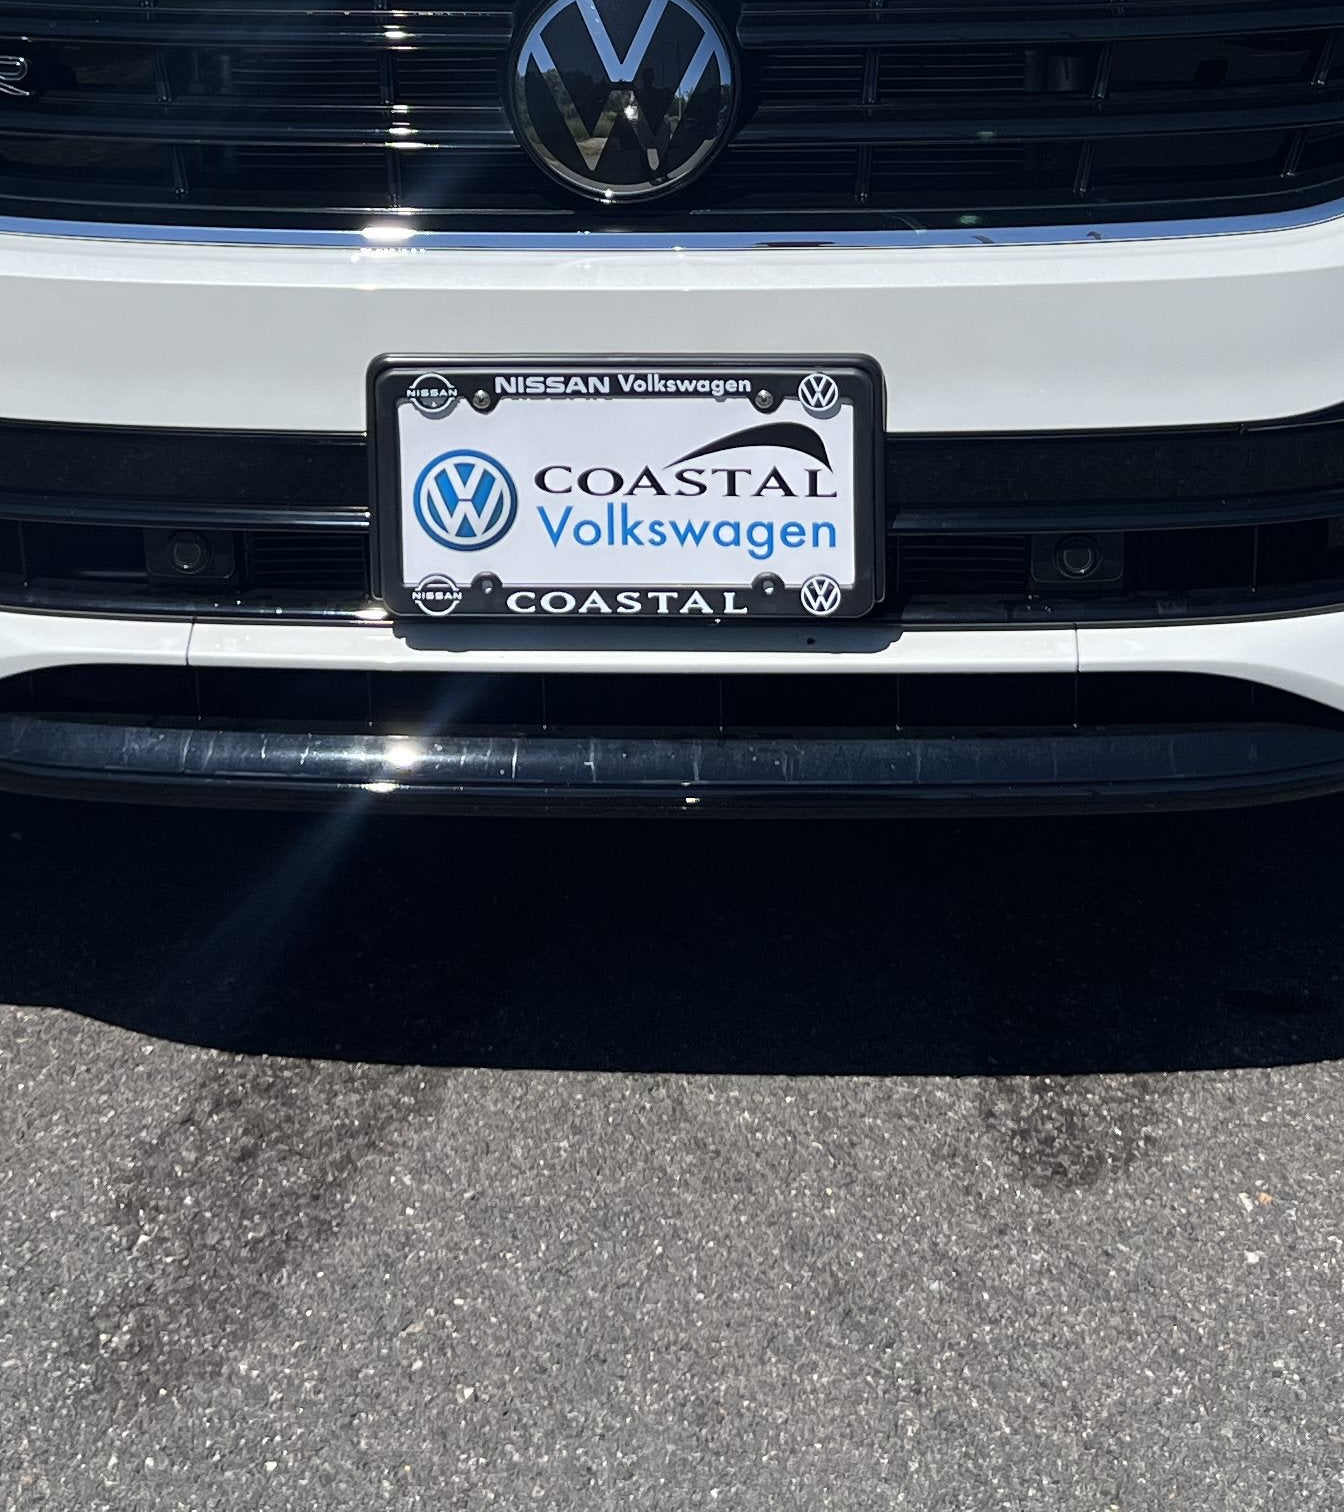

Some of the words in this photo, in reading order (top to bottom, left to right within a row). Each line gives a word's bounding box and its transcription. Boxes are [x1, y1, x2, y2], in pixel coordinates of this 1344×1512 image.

[406, 388, 458, 397] NISSAN
[494, 376, 610, 394] NISSAN
[617, 373, 751, 396] Volkswagen
[534, 465, 838, 498] COASTAL
[537, 503, 837, 560] Volkswagen
[412, 592, 462, 600] NISSAN
[506, 590, 748, 614] COASTAL
